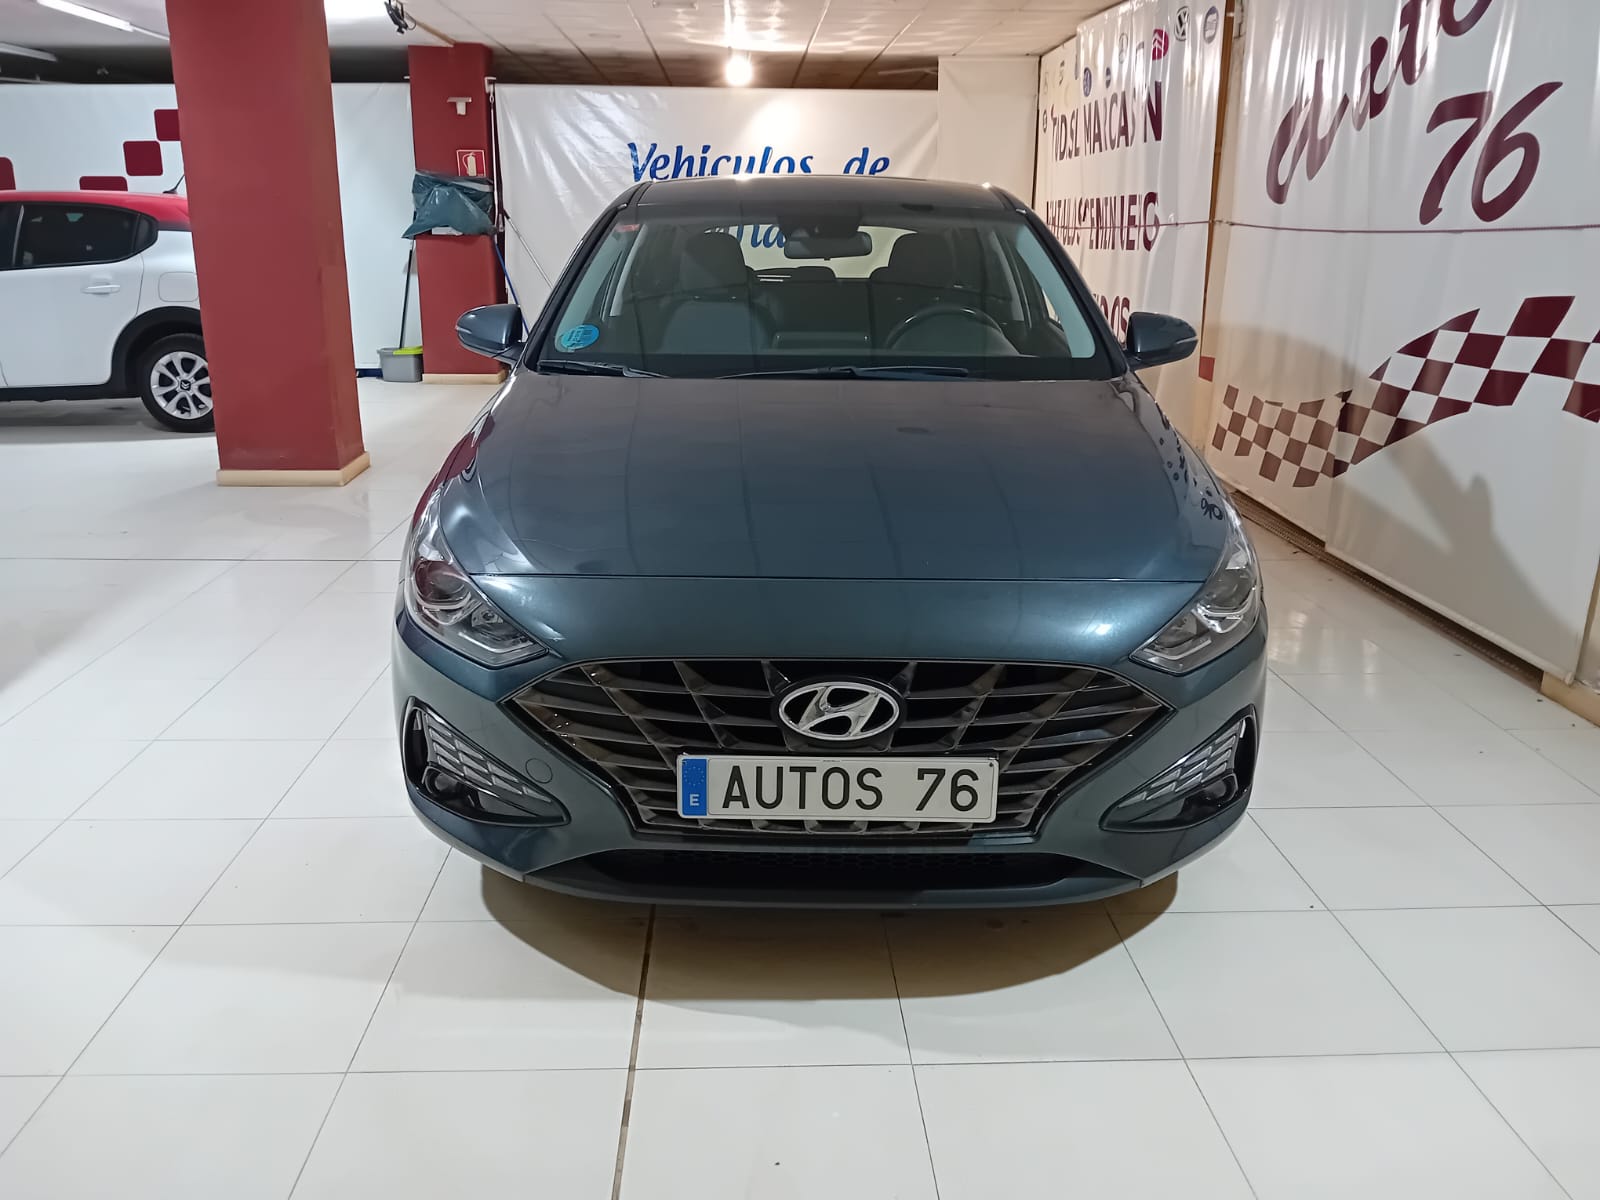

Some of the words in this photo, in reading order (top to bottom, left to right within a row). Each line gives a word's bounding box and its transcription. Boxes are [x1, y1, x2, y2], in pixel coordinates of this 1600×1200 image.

[843, 147, 890, 176] de
[1418, 81, 1564, 225] 76
[689, 793, 699, 806] E
[722, 765, 883, 811] AUTOS
[915, 767, 980, 812] 76
